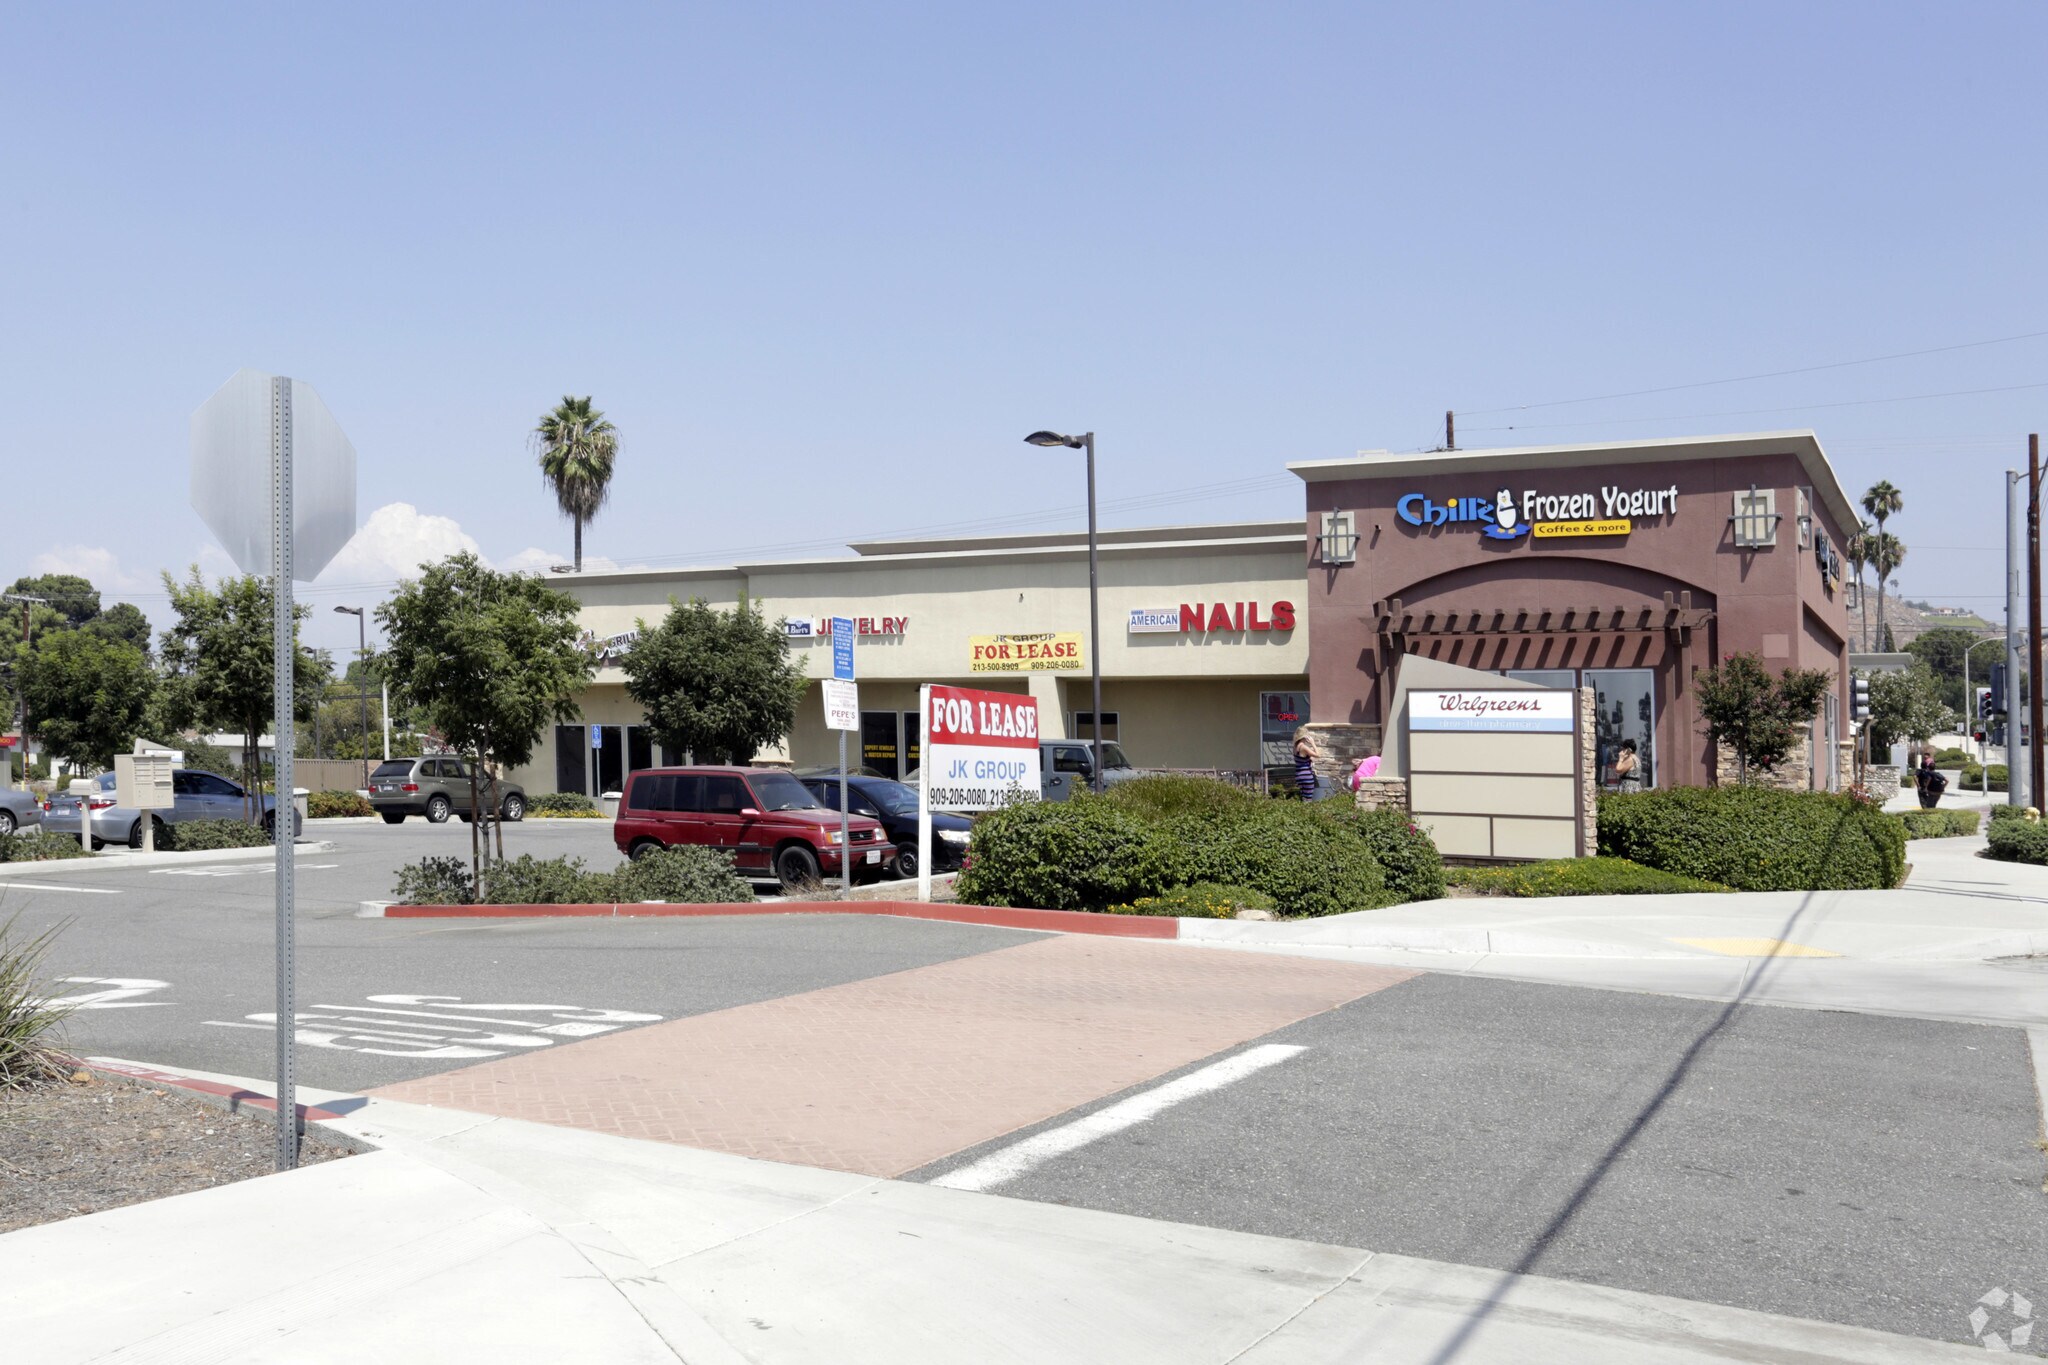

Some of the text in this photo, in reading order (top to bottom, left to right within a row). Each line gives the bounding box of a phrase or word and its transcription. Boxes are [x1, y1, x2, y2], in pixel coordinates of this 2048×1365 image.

[1522, 490, 1595, 520] Frozen
[1601, 485, 1679, 517] Yogurt
[1538, 523, 1627, 534] Coffee & more
[1130, 600, 1296, 632] AMERICAN NAILS
[993, 633, 1056, 643] JK GROUP
[974, 642, 1078, 660] FOR LEASE
[973, 660, 1079, 671] 213-500-8909 909-206-0080
[831, 709, 856, 720] PEPE'S
[1438, 694, 1541, 717] Walgreens
[932, 697, 1037, 739] FOR LEASE
[1278, 713, 1299, 721] OPEN
[948, 759, 1027, 780] JK GROUP
[930, 787, 987, 806] 909-206-0080
